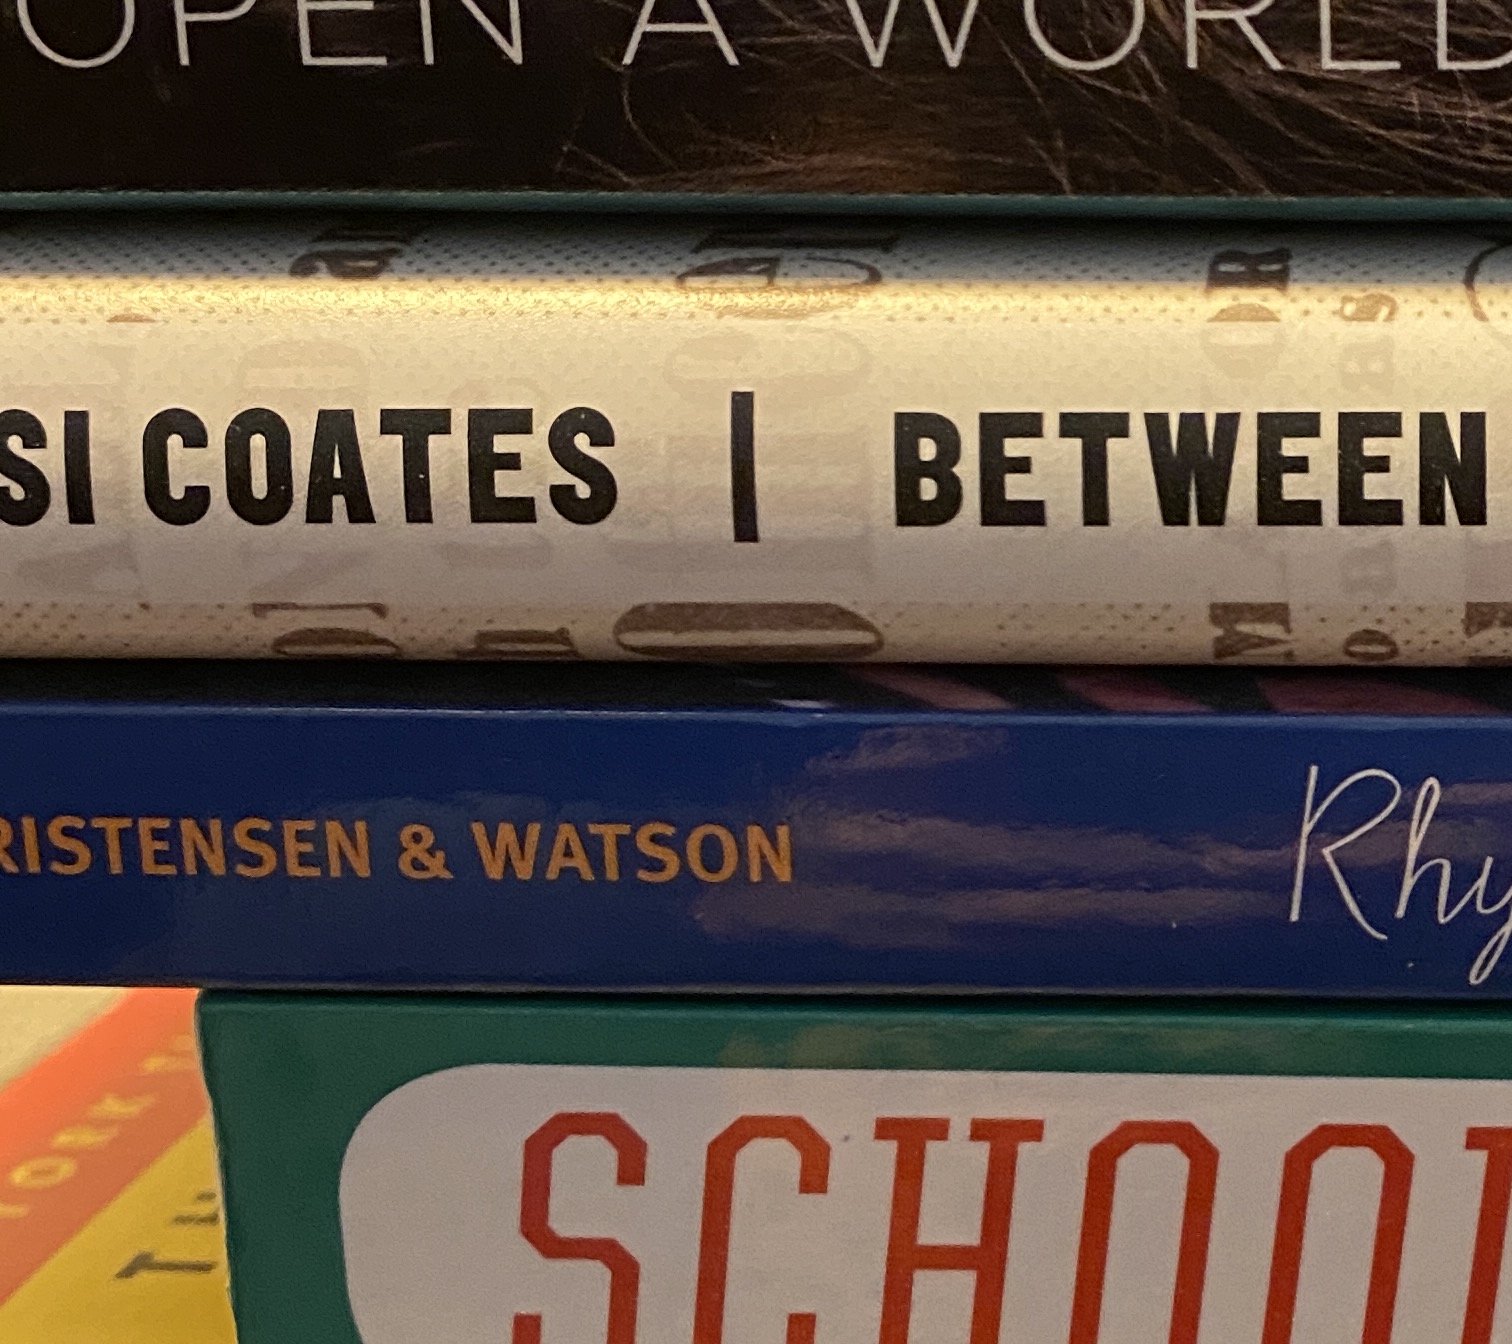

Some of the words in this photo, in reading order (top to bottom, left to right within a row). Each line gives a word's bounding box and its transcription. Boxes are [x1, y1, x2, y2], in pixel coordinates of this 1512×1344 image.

[0, 408, 96, 527] SI
[142, 406, 618, 526] COATES
[893, 411, 1488, 527] BETWEEN
[398, 823, 452, 880] &
[471, 821, 794, 884] WATSON
